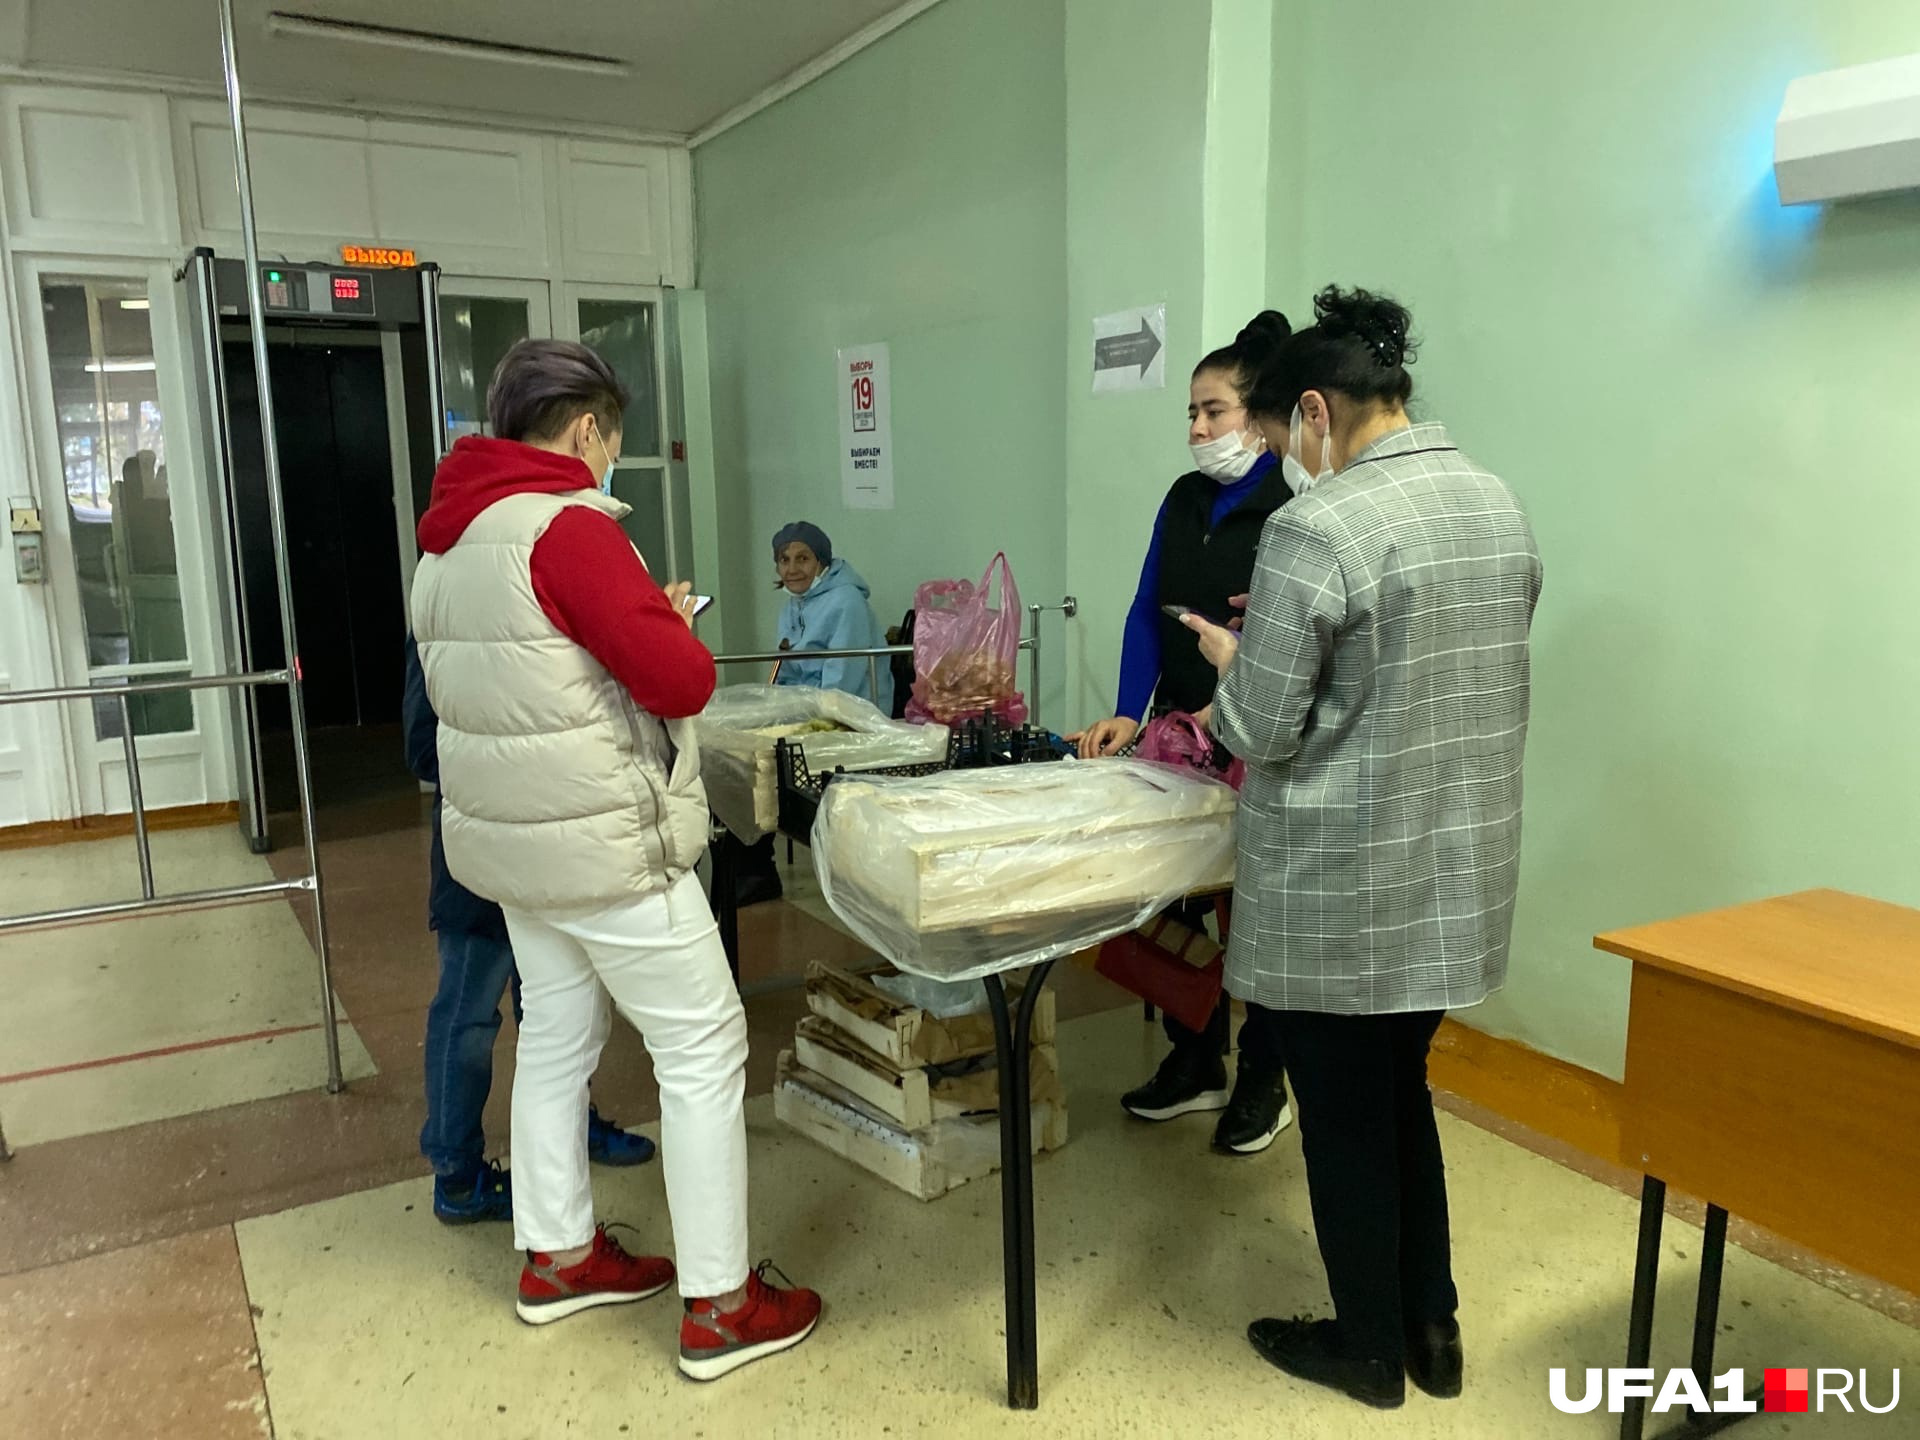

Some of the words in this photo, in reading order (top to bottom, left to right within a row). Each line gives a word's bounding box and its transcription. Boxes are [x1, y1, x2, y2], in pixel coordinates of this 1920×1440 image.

[343, 246, 416, 267] ВЫХОД
[853, 377, 872, 410] 19
[850, 447, 881, 458] ВЫБИРАЕМ
